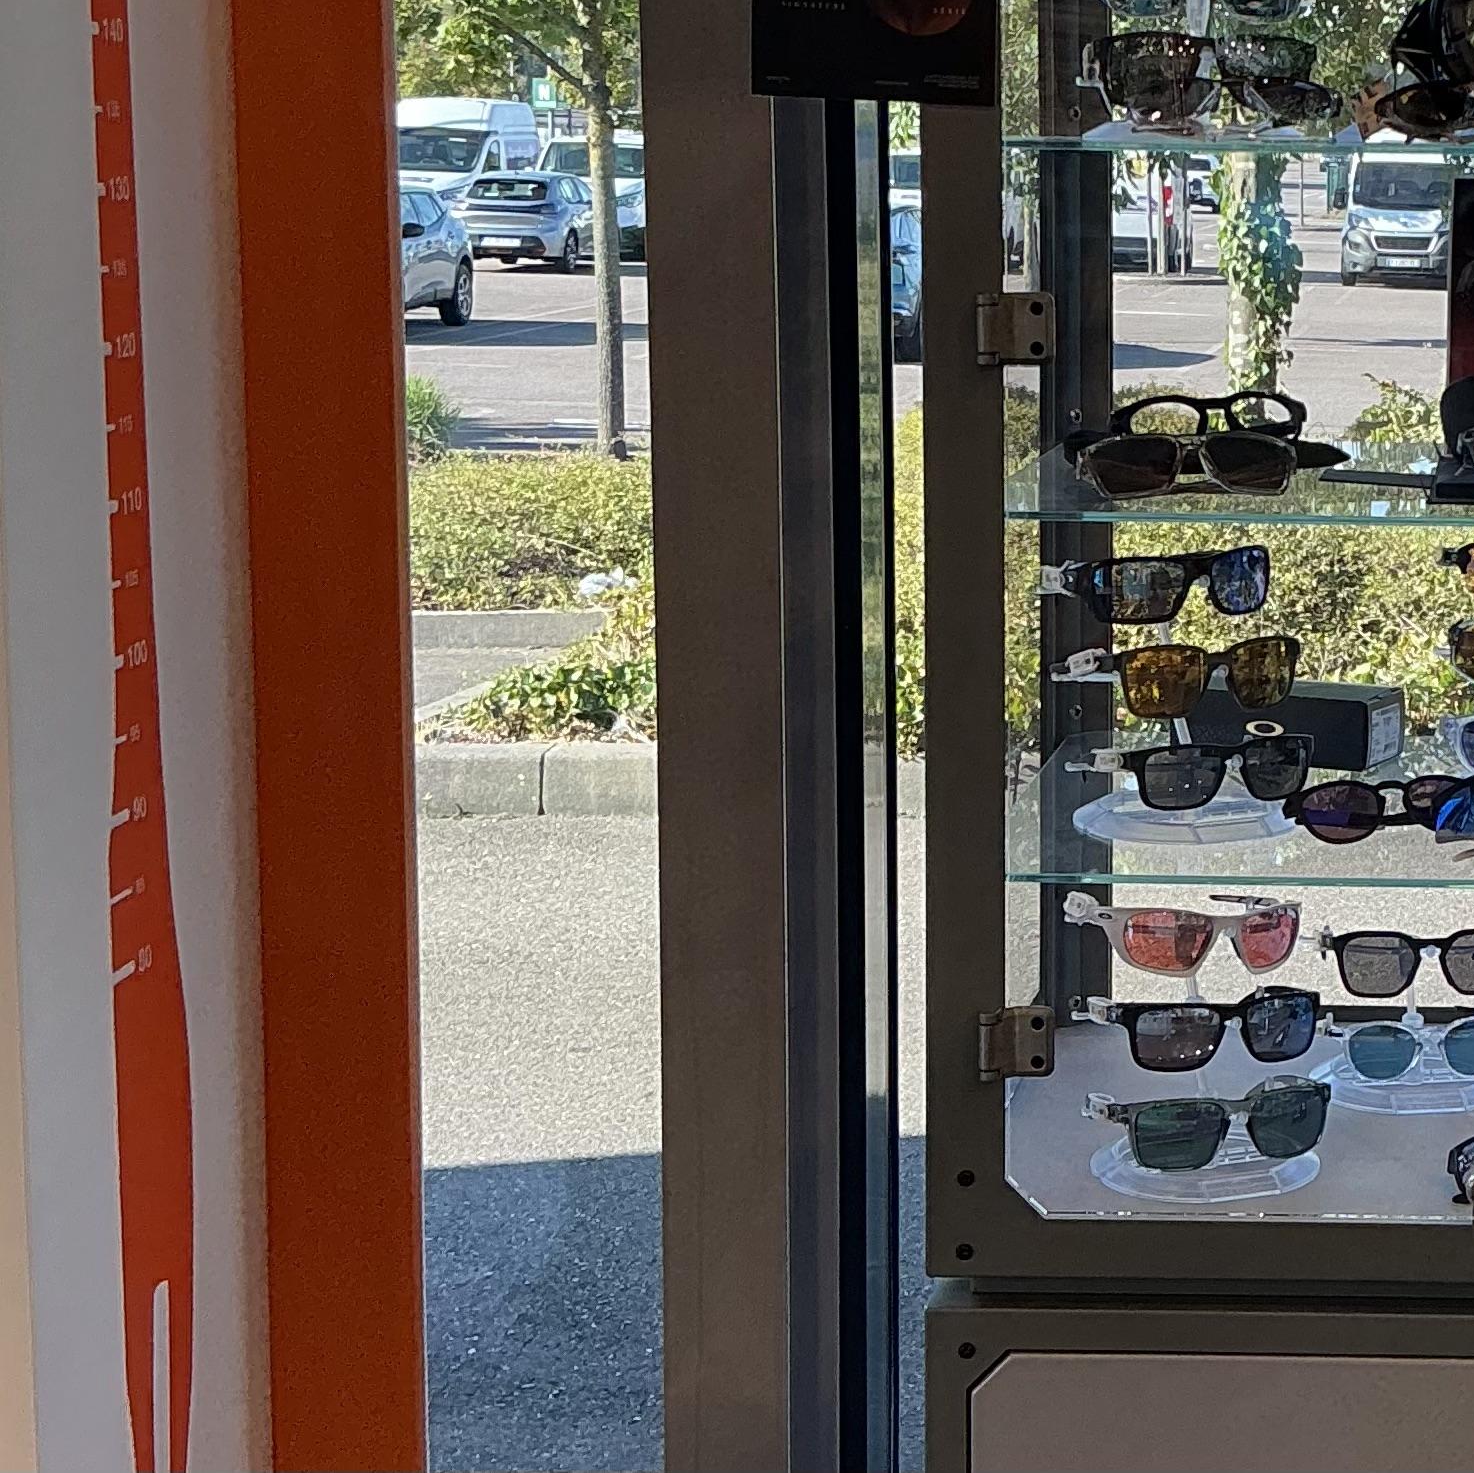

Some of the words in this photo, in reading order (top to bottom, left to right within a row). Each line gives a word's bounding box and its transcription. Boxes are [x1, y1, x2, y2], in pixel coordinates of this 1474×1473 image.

[103, 17, 124, 43] 140
[108, 176, 130, 202] 130
[116, 332, 136, 358] 120
[122, 486, 142, 515] 110
[127, 640, 148, 669] 100
